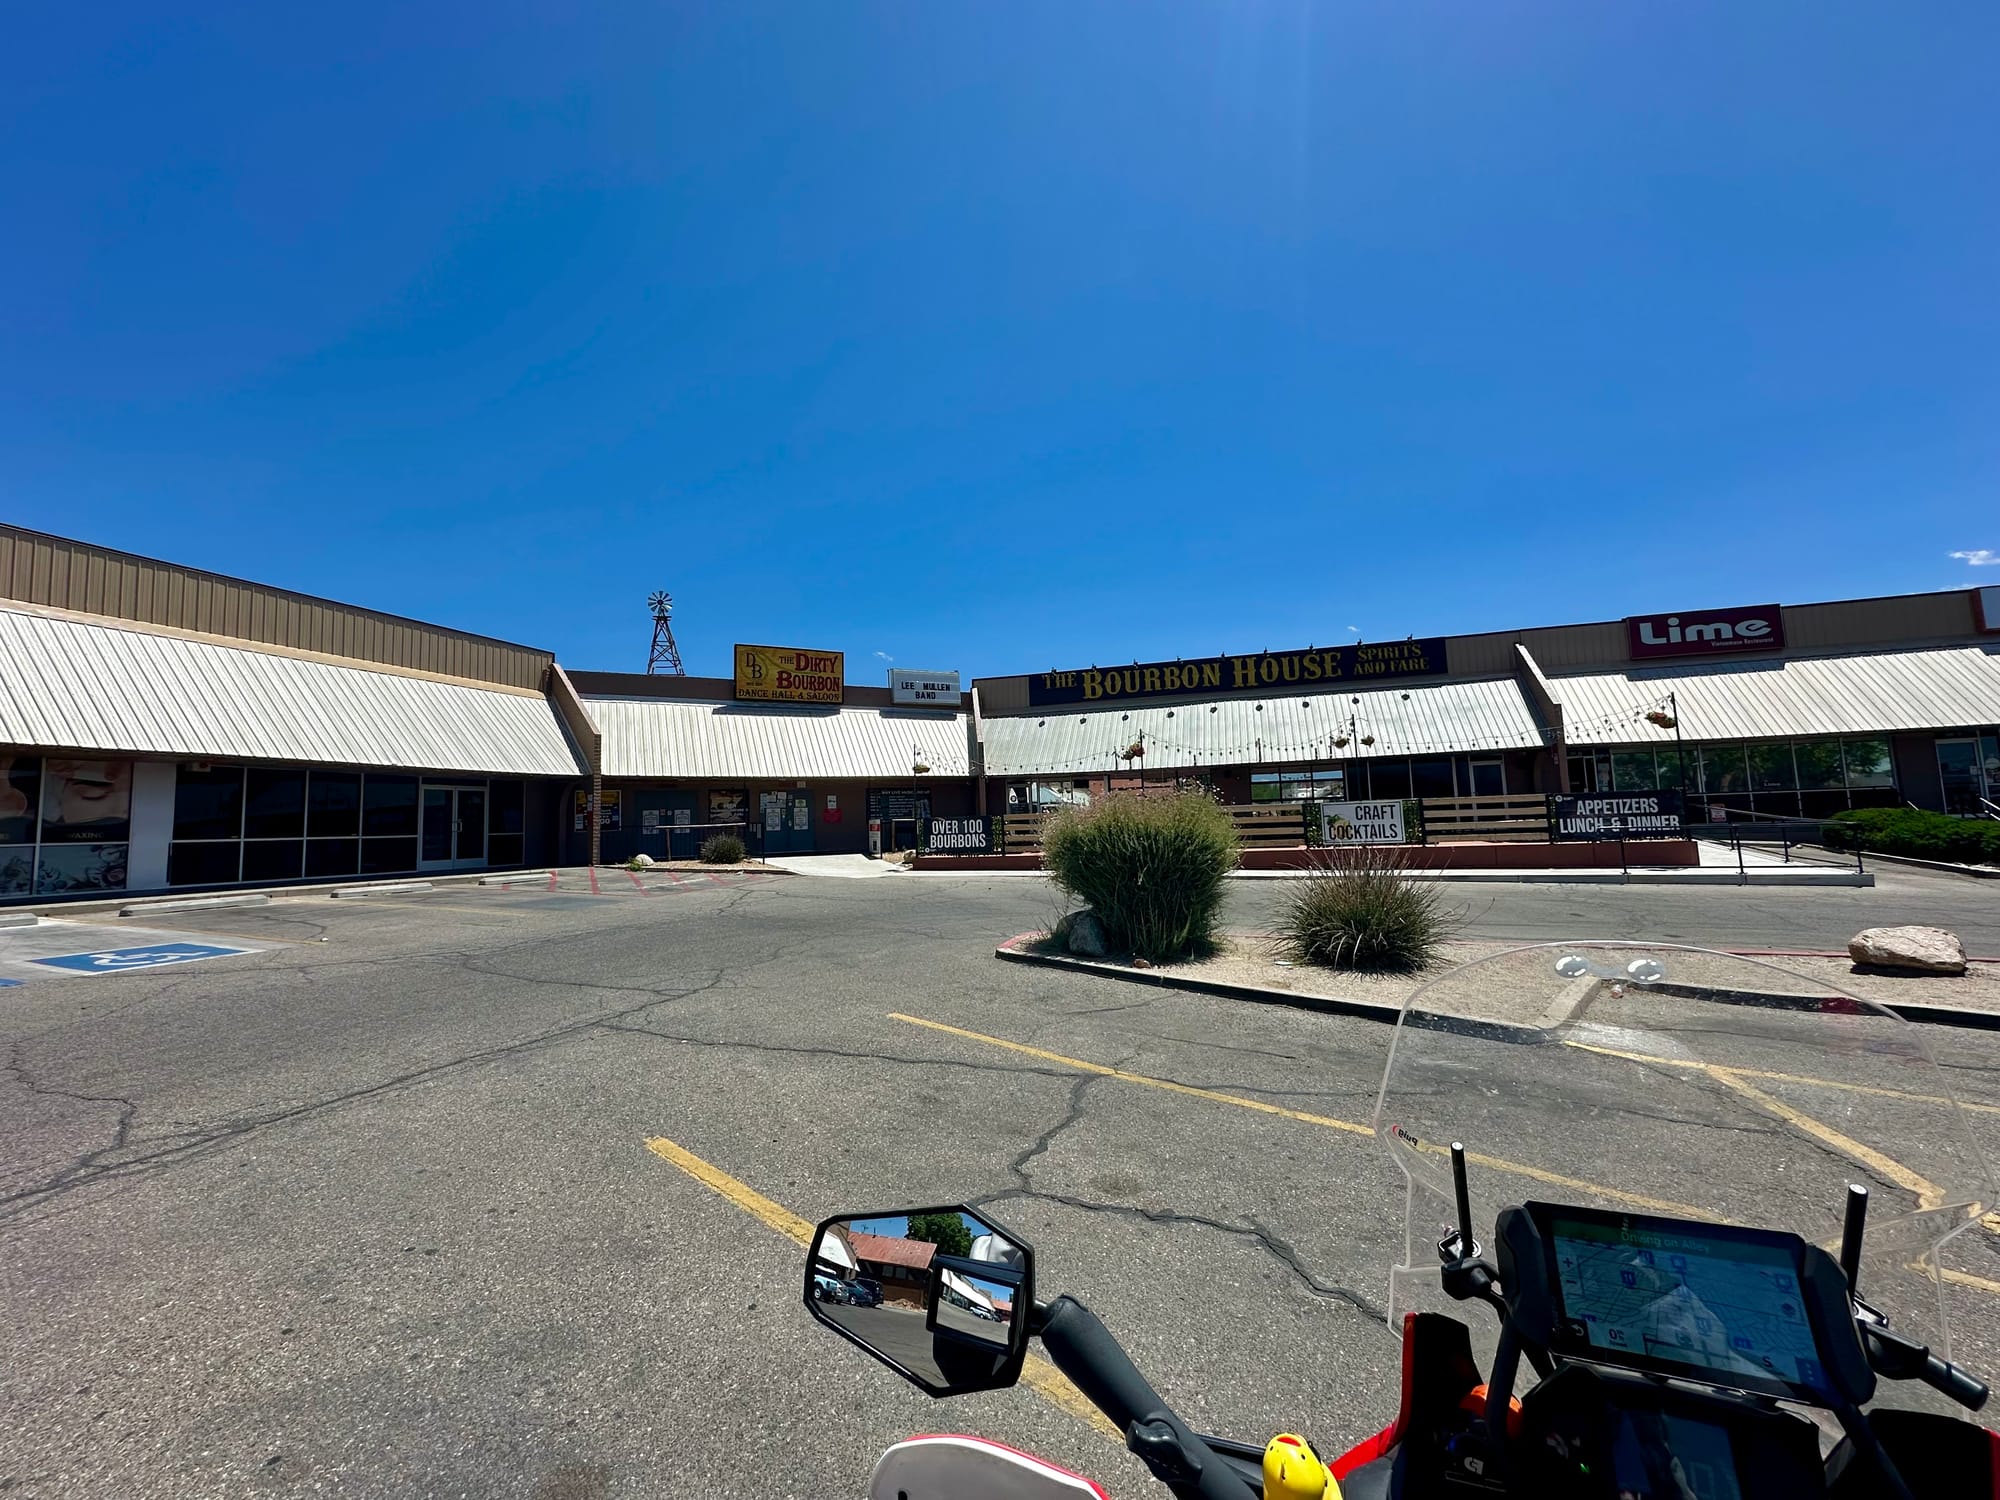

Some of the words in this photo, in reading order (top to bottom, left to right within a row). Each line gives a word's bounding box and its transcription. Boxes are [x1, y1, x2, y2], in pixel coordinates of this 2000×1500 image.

[1639, 617, 1772, 645] Lime
[1357, 643, 1422, 662] SPIRITS
[779, 656, 795, 665] THE
[795, 652, 838, 673] DIRTY
[1353, 661, 1386, 676] AND
[1390, 656, 1430, 672] FARE
[776, 670, 840, 691] BOURBON
[1041, 672, 1077, 689] THE
[1082, 662, 1220, 700] BOURBON
[1231, 652, 1343, 688] HOUSE
[901, 681, 915, 690] LEE
[739, 688, 768, 698] DANCE
[771, 690, 795, 699] HALL
[806, 692, 840, 701] SALOON
[915, 691, 936, 700] BAND
[1355, 804, 1396, 821] CRAFT
[1576, 797, 1659, 815] APPETIZERS
[932, 820, 959, 834] OVER
[962, 819, 983, 833] 100
[1329, 823, 1398, 840] COCKTAILS
[1559, 817, 1604, 834] LUNCH
[1611, 816, 1621, 832] &
[1628, 815, 1681, 832] DINNER
[930, 833, 987, 848] BOURBONS
[1665, 1239, 1679, 1247] on
